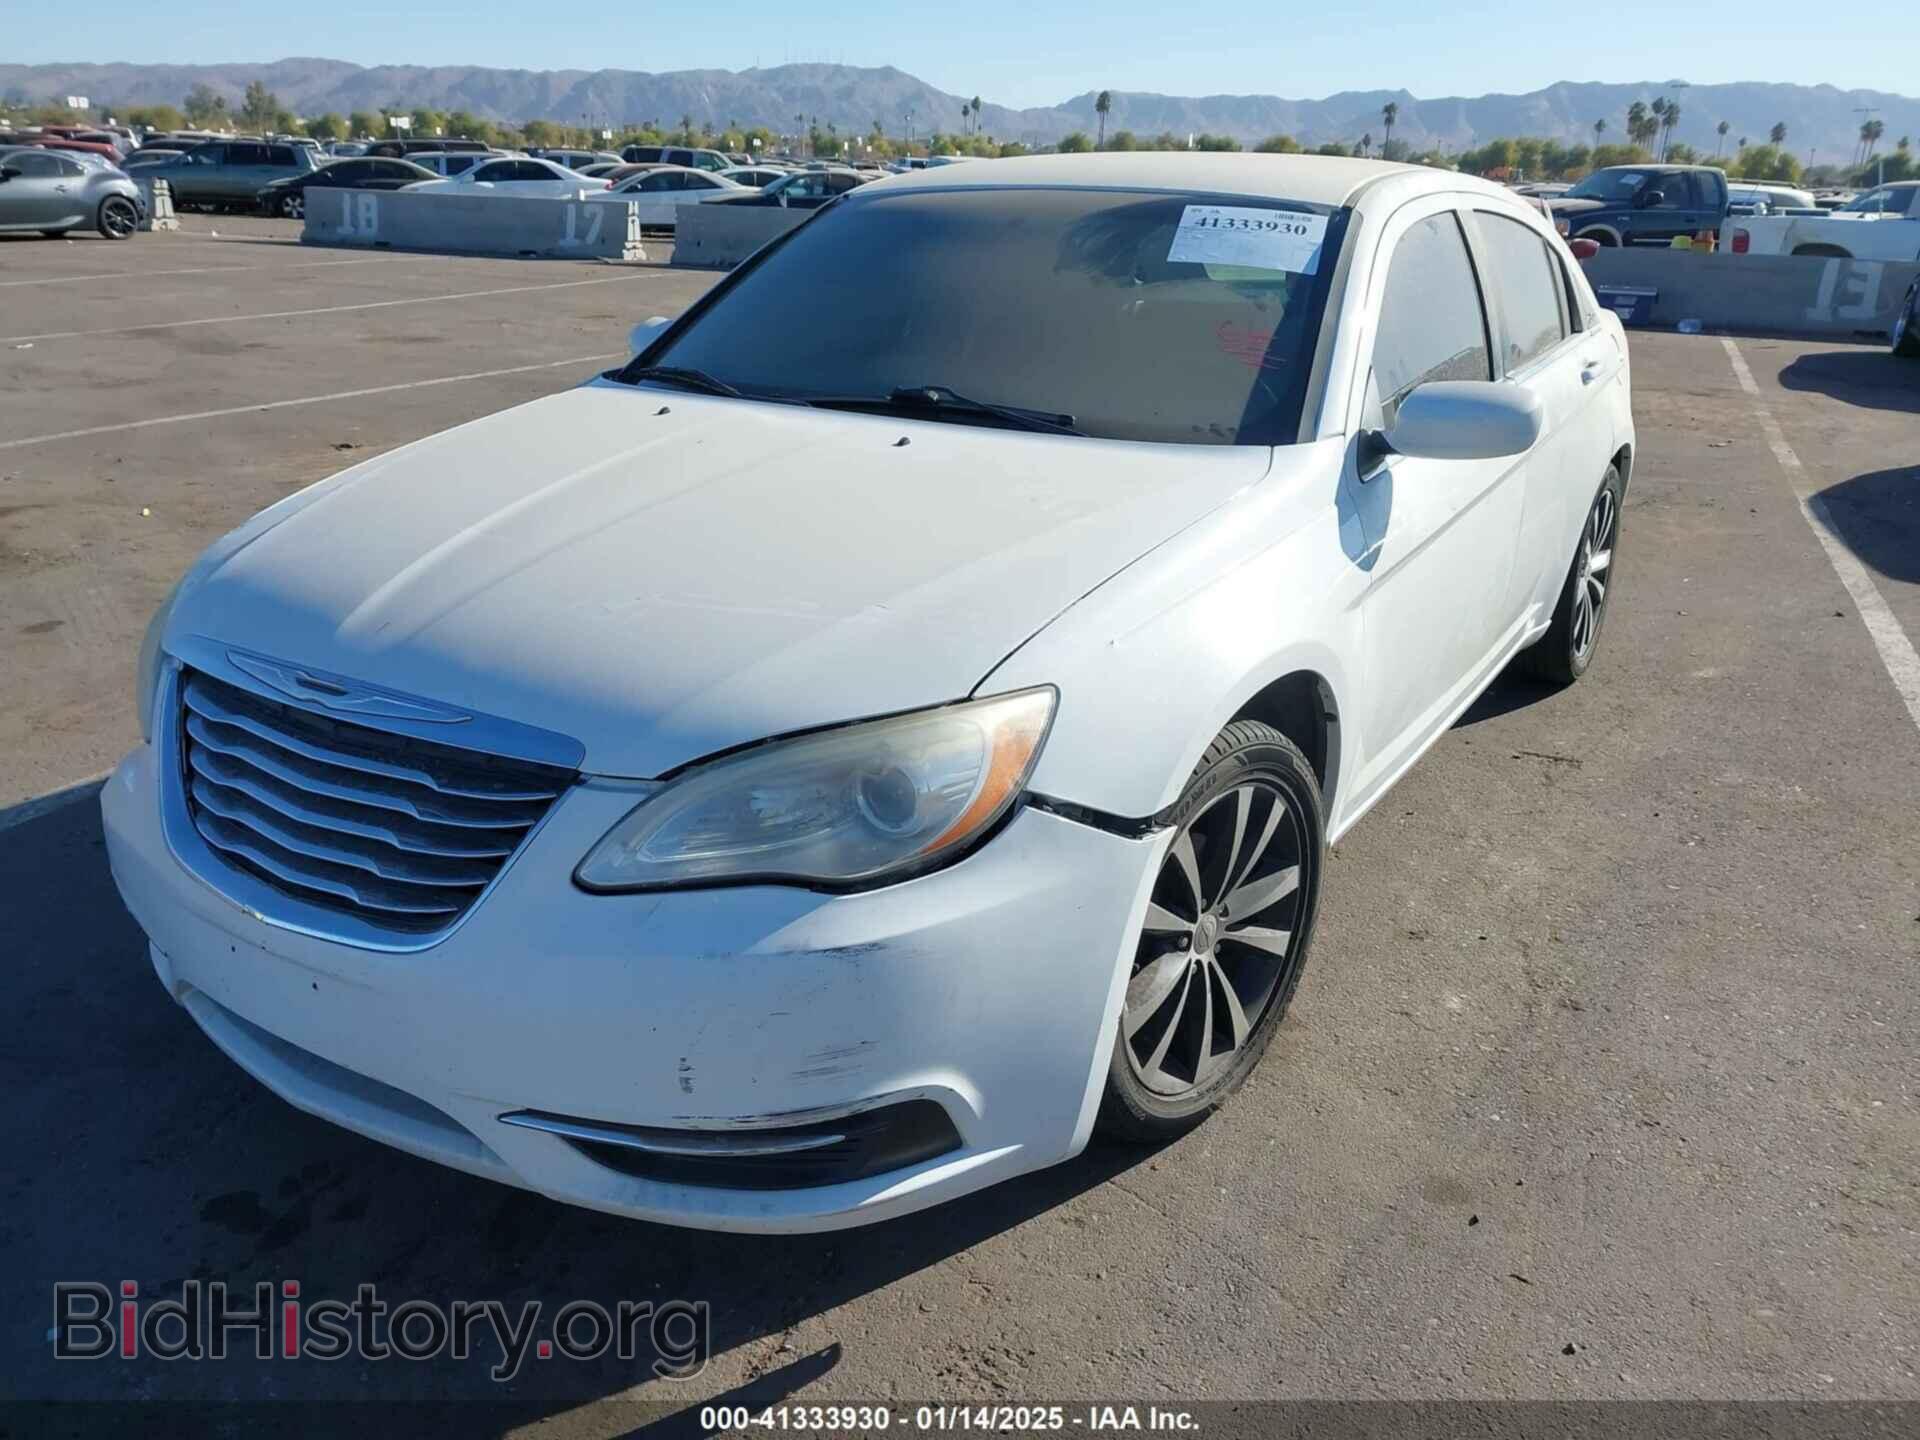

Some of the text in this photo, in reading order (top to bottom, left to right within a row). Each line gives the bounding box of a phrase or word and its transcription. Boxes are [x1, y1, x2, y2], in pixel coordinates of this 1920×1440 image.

[336, 191, 378, 236] 18
[558, 202, 605, 248] 17
[1194, 216, 1308, 236] 41333930
